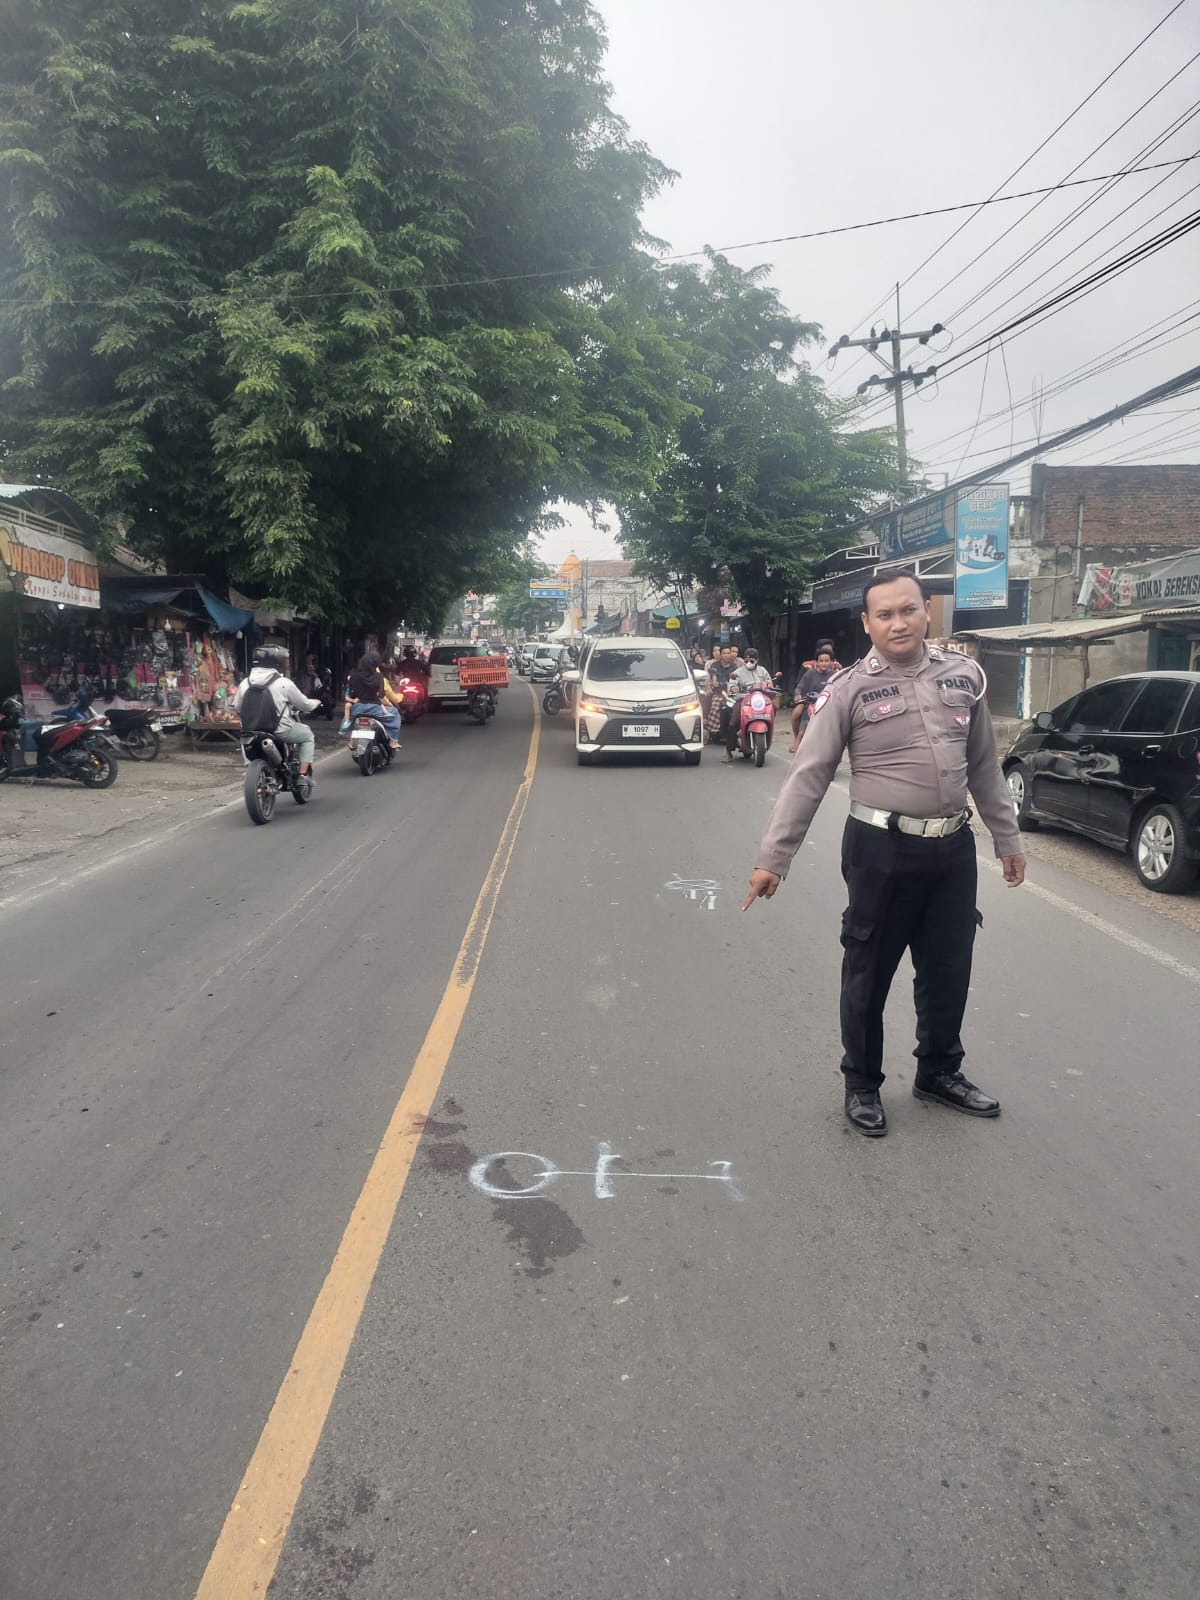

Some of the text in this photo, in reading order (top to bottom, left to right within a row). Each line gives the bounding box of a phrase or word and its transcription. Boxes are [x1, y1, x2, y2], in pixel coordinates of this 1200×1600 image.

[8, 541, 66, 583] WARKOP
[1135, 579, 1162, 600] VOKAL
[936, 678, 970, 690] POLRI
[861, 685, 900, 704] RENO.H
